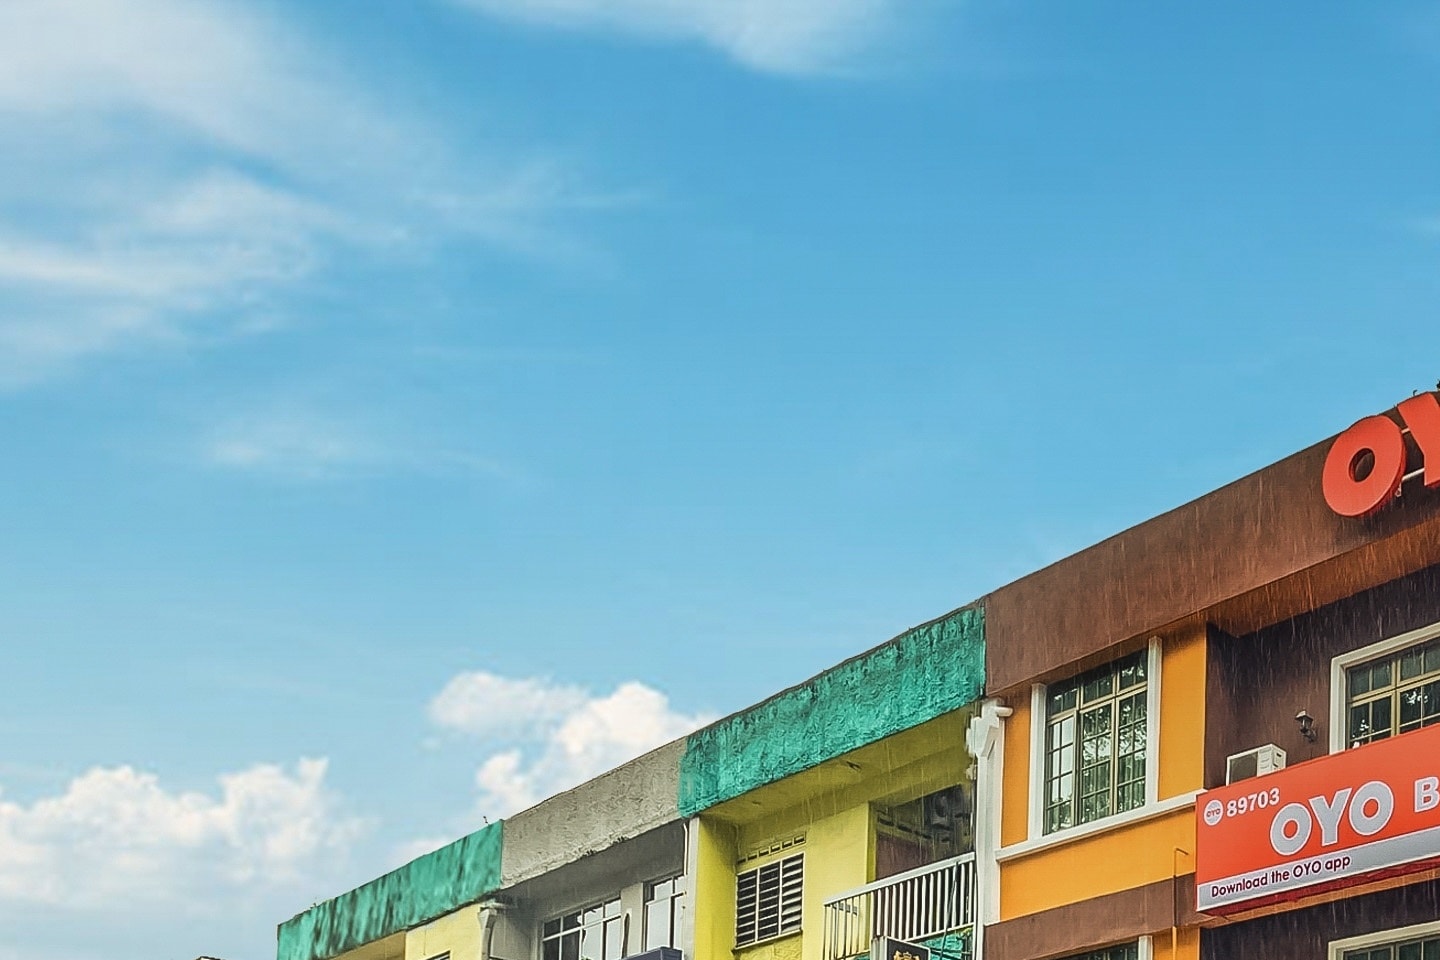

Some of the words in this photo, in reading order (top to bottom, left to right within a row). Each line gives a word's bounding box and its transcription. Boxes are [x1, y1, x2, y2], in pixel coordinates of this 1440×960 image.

[1226, 787, 1280, 817] 89703
[1414, 775, 1440, 813] B
[1269, 780, 1395, 856] OYO
[1211, 873, 1268, 898] Download
[1271, 869, 1290, 884] the
[1292, 860, 1322, 878] OYO
[1325, 856, 1351, 873] app
